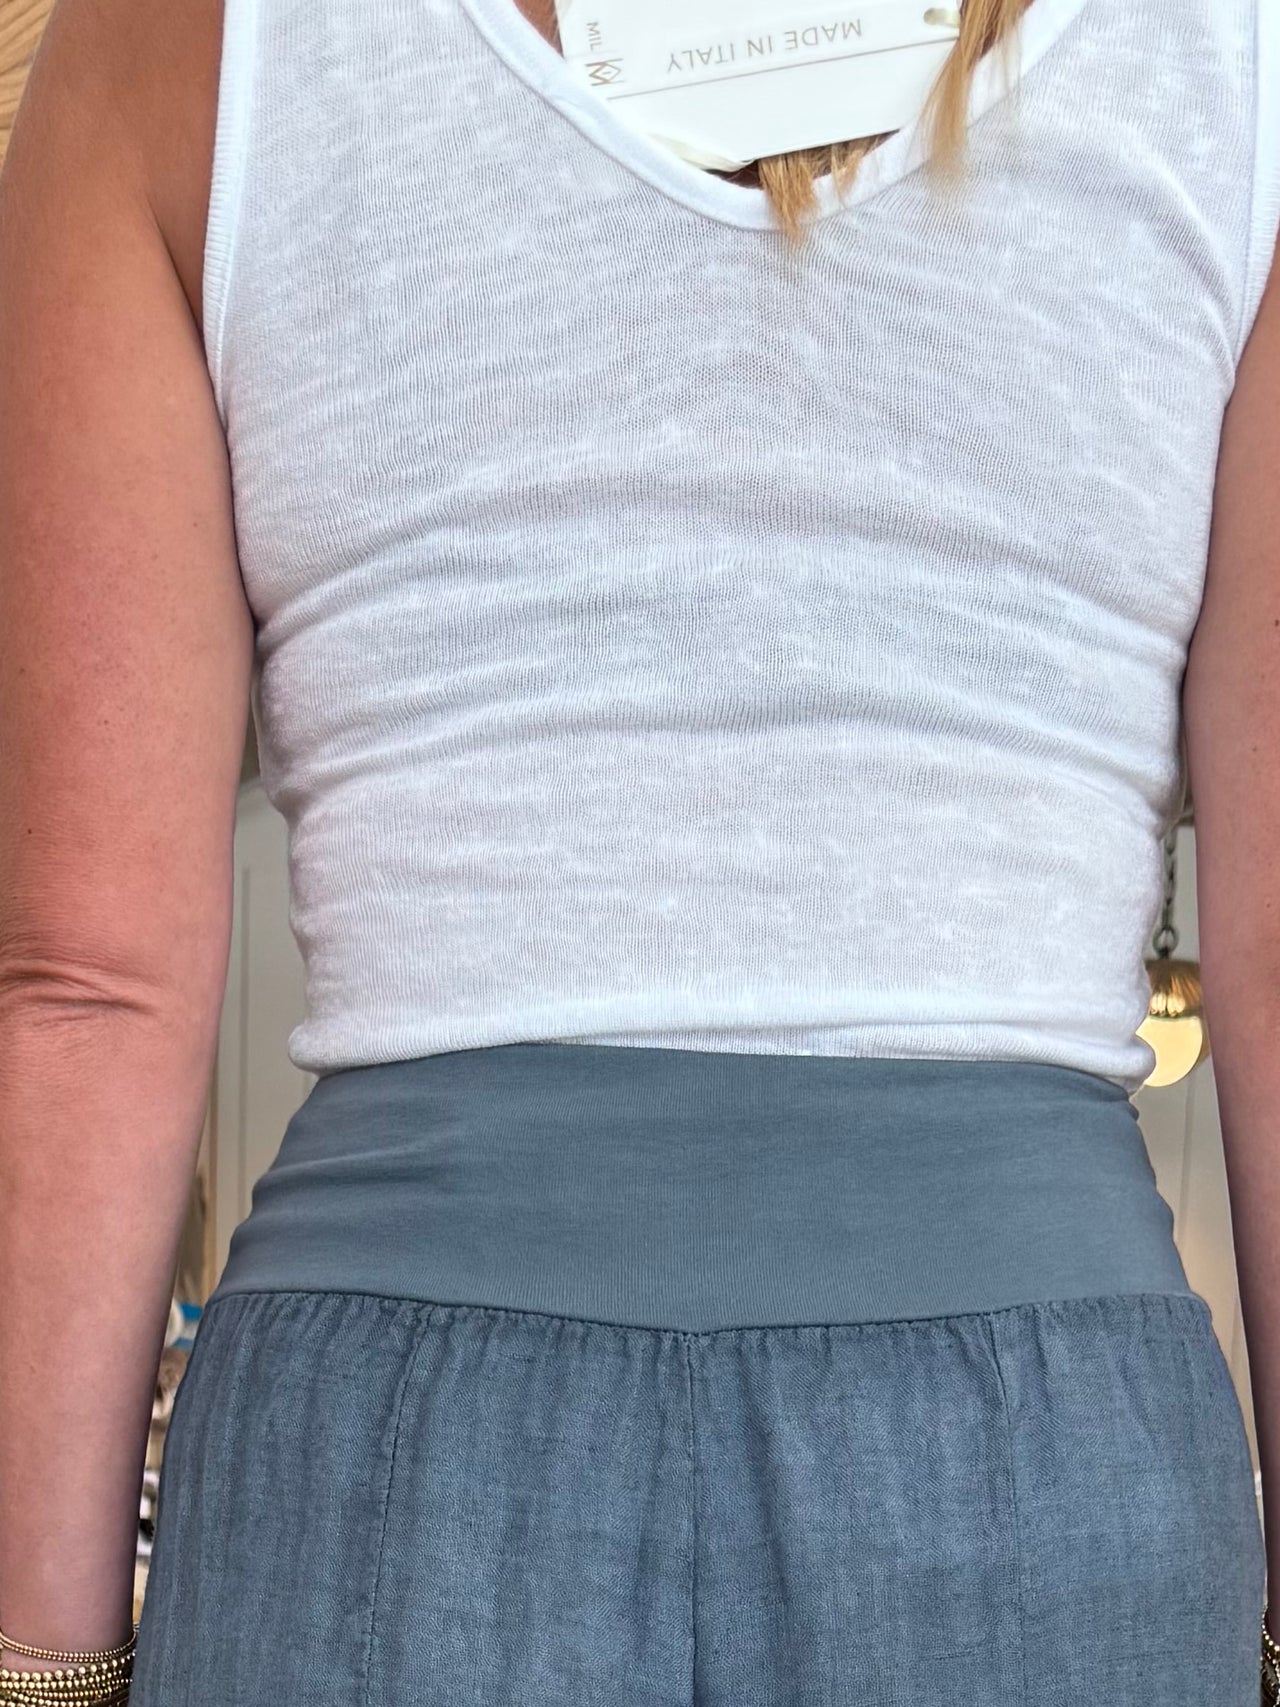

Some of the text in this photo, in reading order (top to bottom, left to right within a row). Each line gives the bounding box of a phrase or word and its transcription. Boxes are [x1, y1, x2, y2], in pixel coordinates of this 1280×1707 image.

[667, 18, 863, 74] MADE IN ITALY
